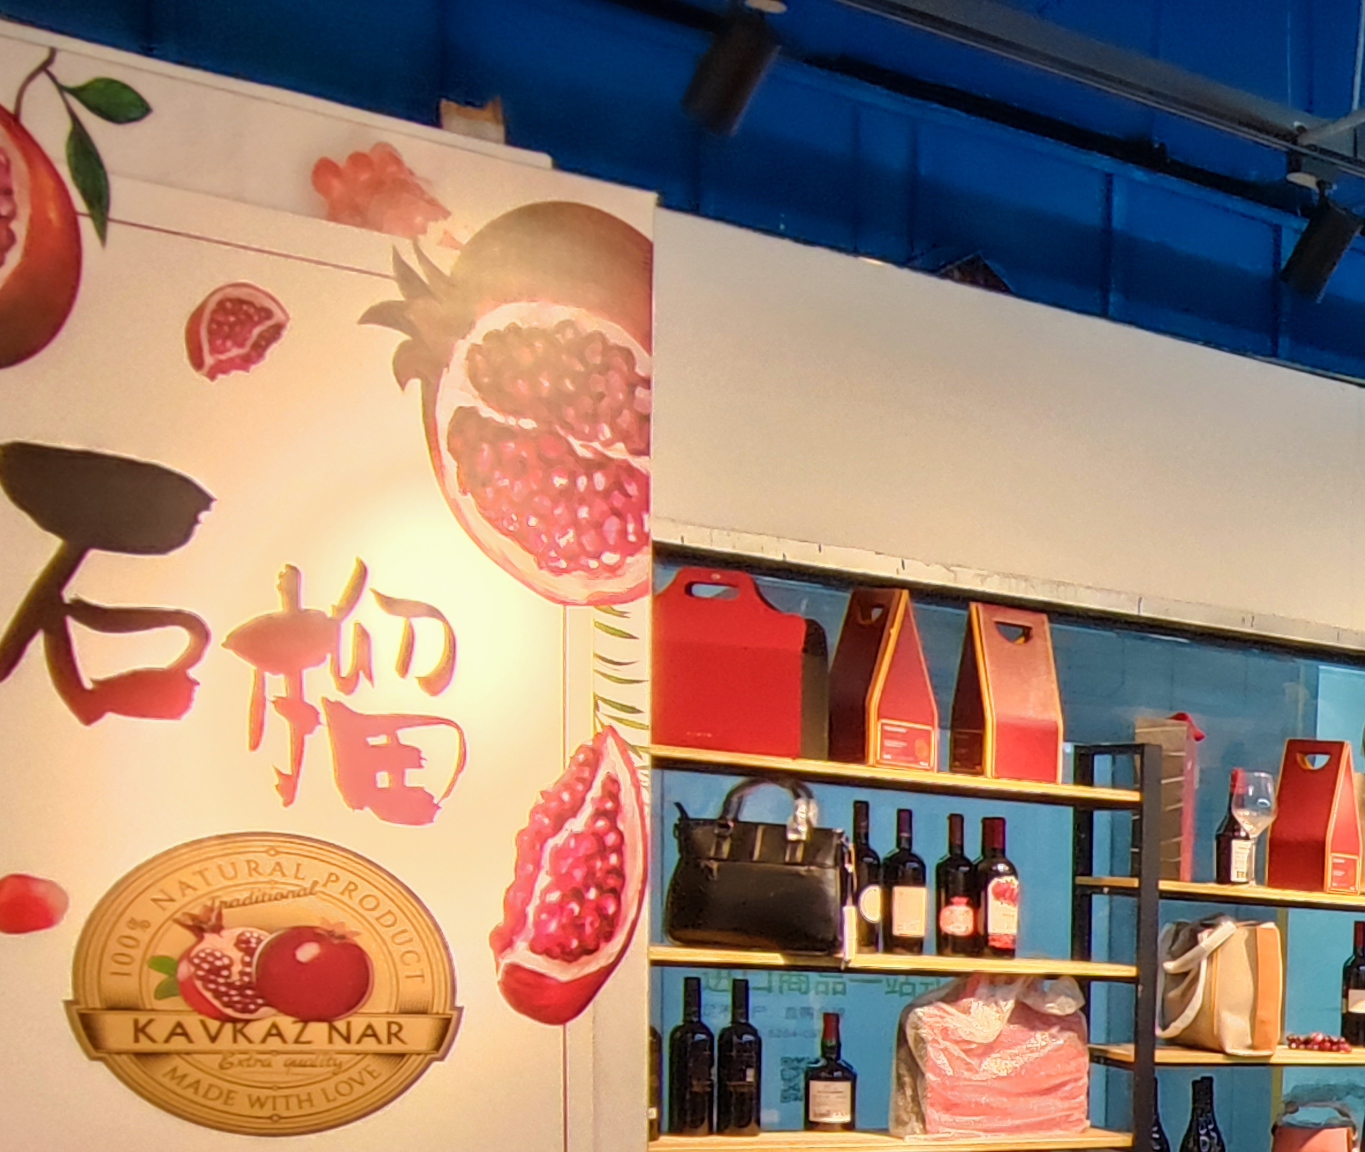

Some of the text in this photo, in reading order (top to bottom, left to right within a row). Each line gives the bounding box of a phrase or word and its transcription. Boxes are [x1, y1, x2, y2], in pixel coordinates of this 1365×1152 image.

[0, 441, 467, 826] 石榴
[208, 879, 320, 910] Traditional
[109, 858, 426, 984] 100% NATURAL PRODUCT
[132, 1018, 408, 1046] KAVKAZ NAR
[217, 1052, 343, 1077] Extra quality
[161, 1064, 381, 1113] MADE WITH LOVE
